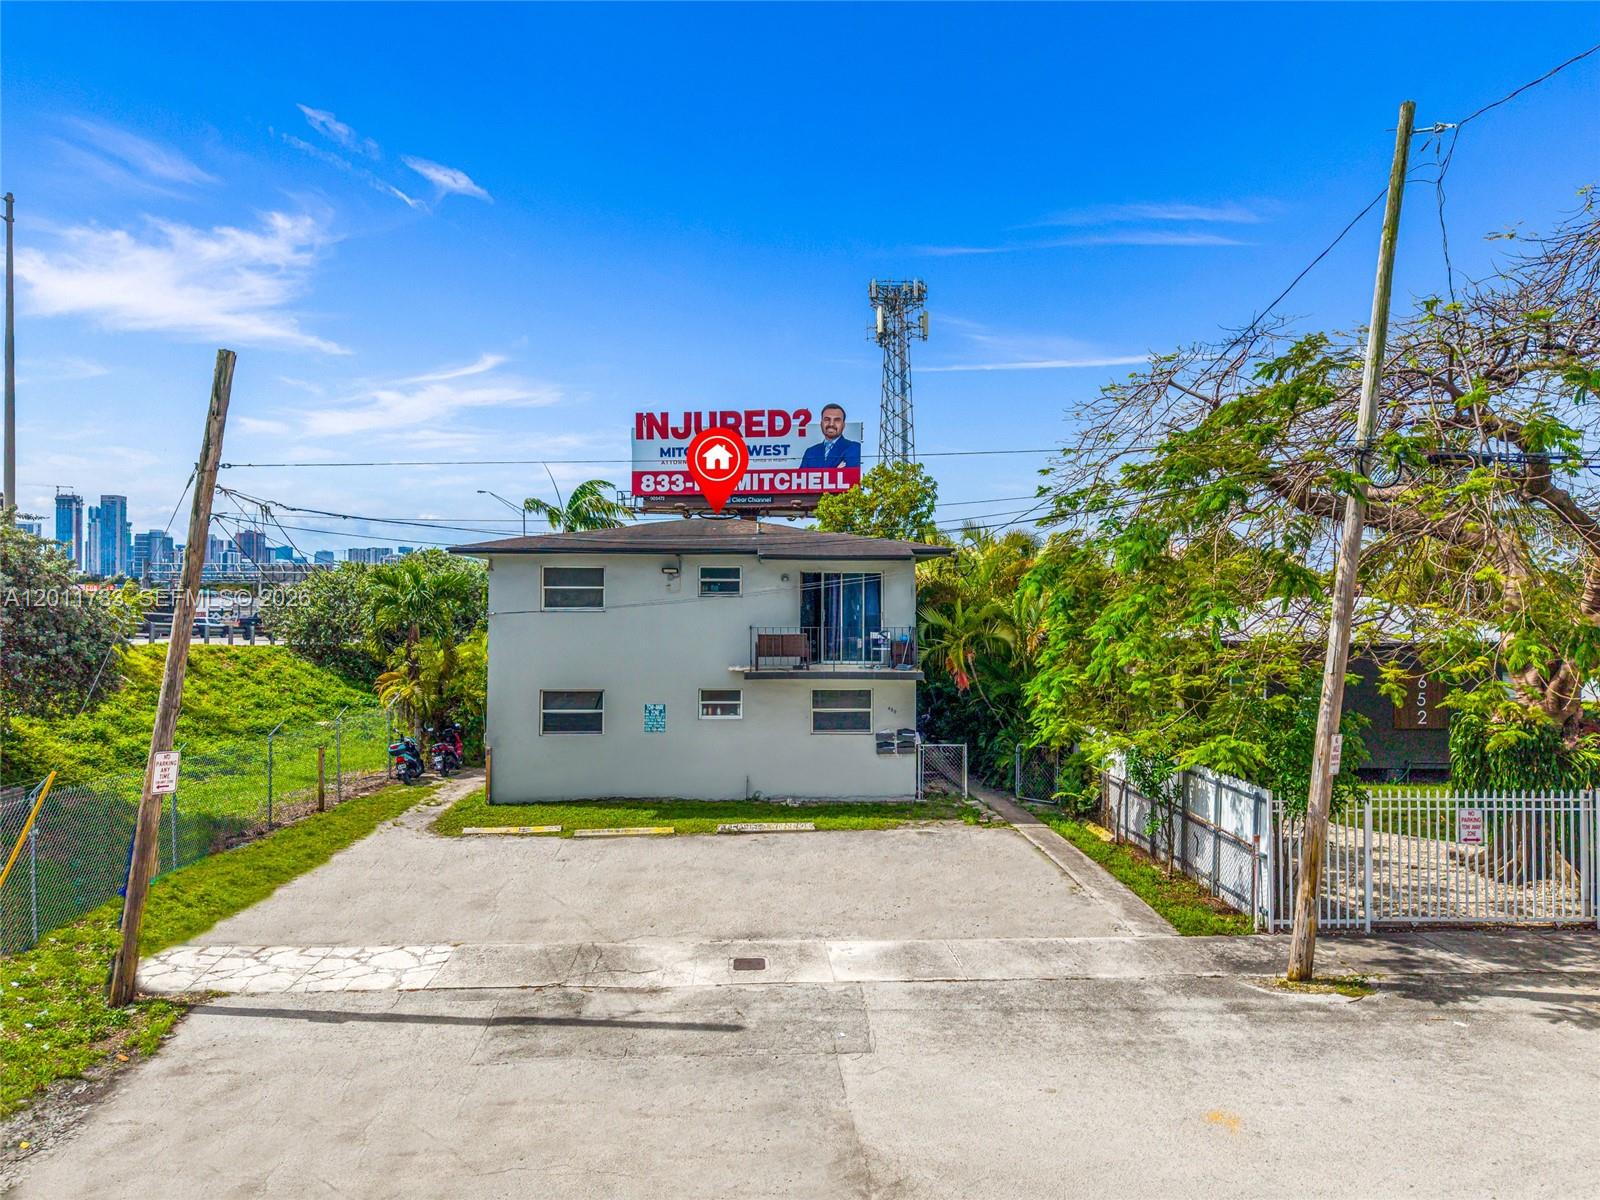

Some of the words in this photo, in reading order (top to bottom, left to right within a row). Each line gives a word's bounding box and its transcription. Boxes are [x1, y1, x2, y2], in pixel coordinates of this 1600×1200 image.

[635, 408, 812, 440] INJURED?
[746, 444, 791, 457] WEST
[1416, 674, 1428, 725] 652
